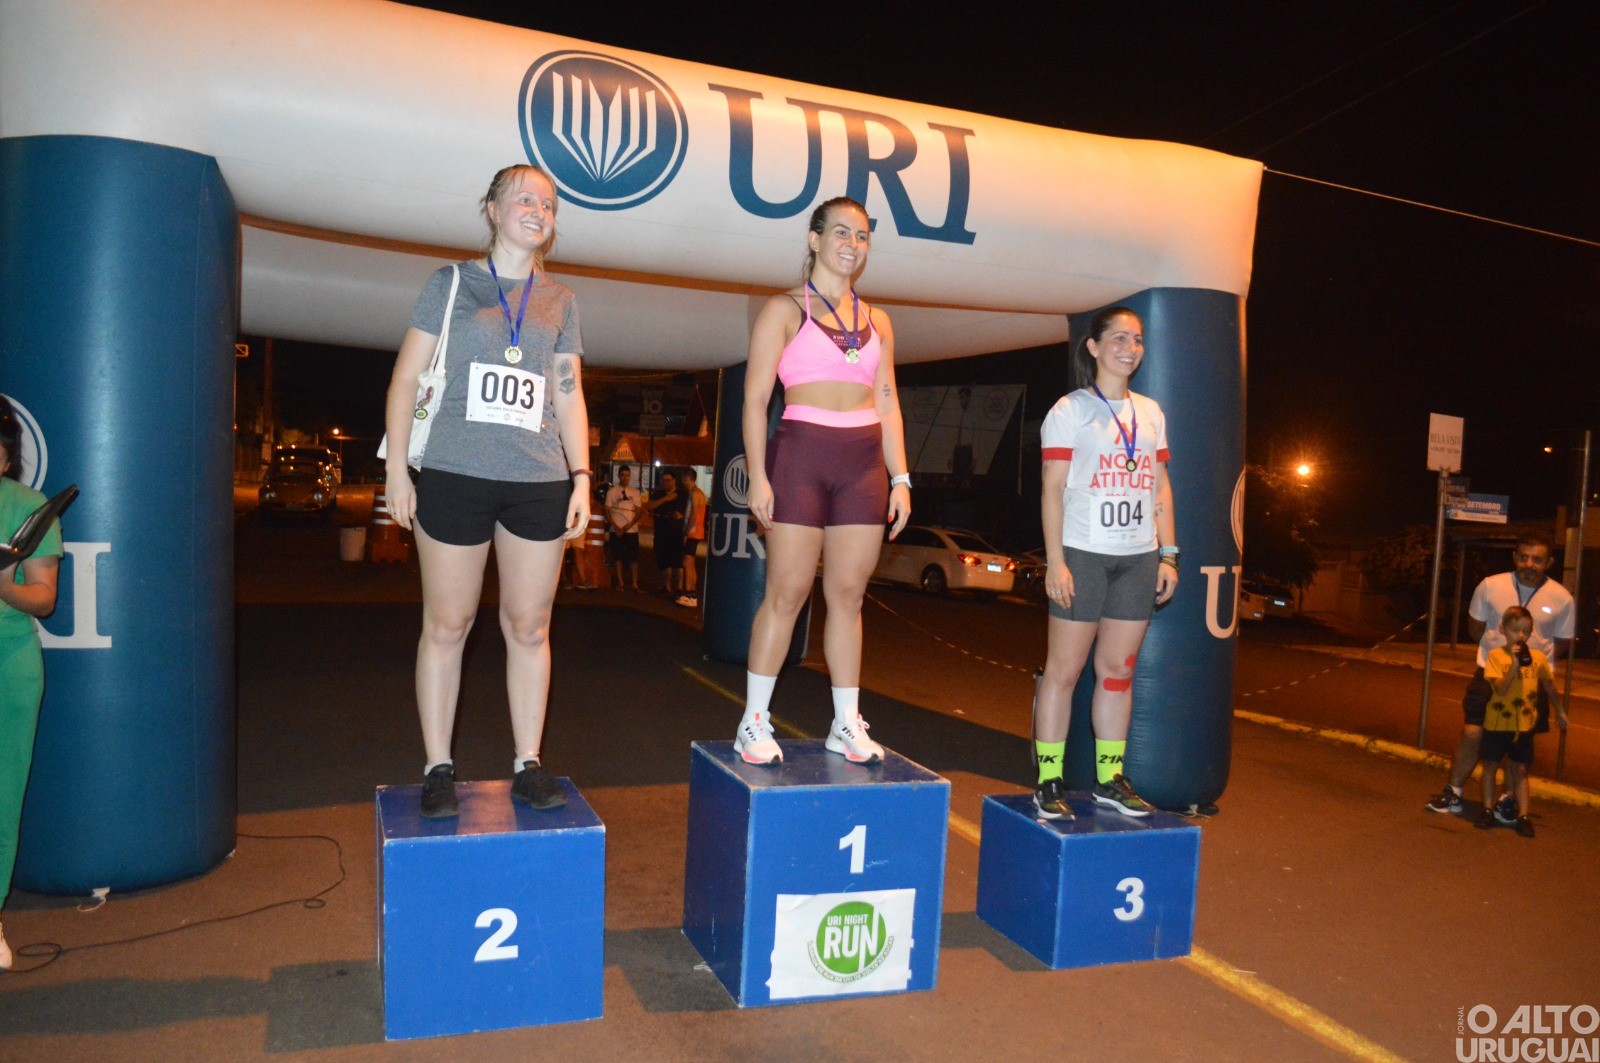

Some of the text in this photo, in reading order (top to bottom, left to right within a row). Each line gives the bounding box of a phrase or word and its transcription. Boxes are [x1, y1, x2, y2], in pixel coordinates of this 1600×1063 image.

[708, 82, 977, 245] URI
[481, 371, 535, 410] 003
[711, 513, 766, 560] UR
[1100, 500, 1143, 528] 004
[1098, 753, 1124, 764] 21K
[839, 825, 866, 874] 1
[827, 913, 869, 926] URI NIGHT
[1113, 877, 1144, 921] 3
[474, 907, 519, 962] 2
[824, 917, 879, 967] RUN
